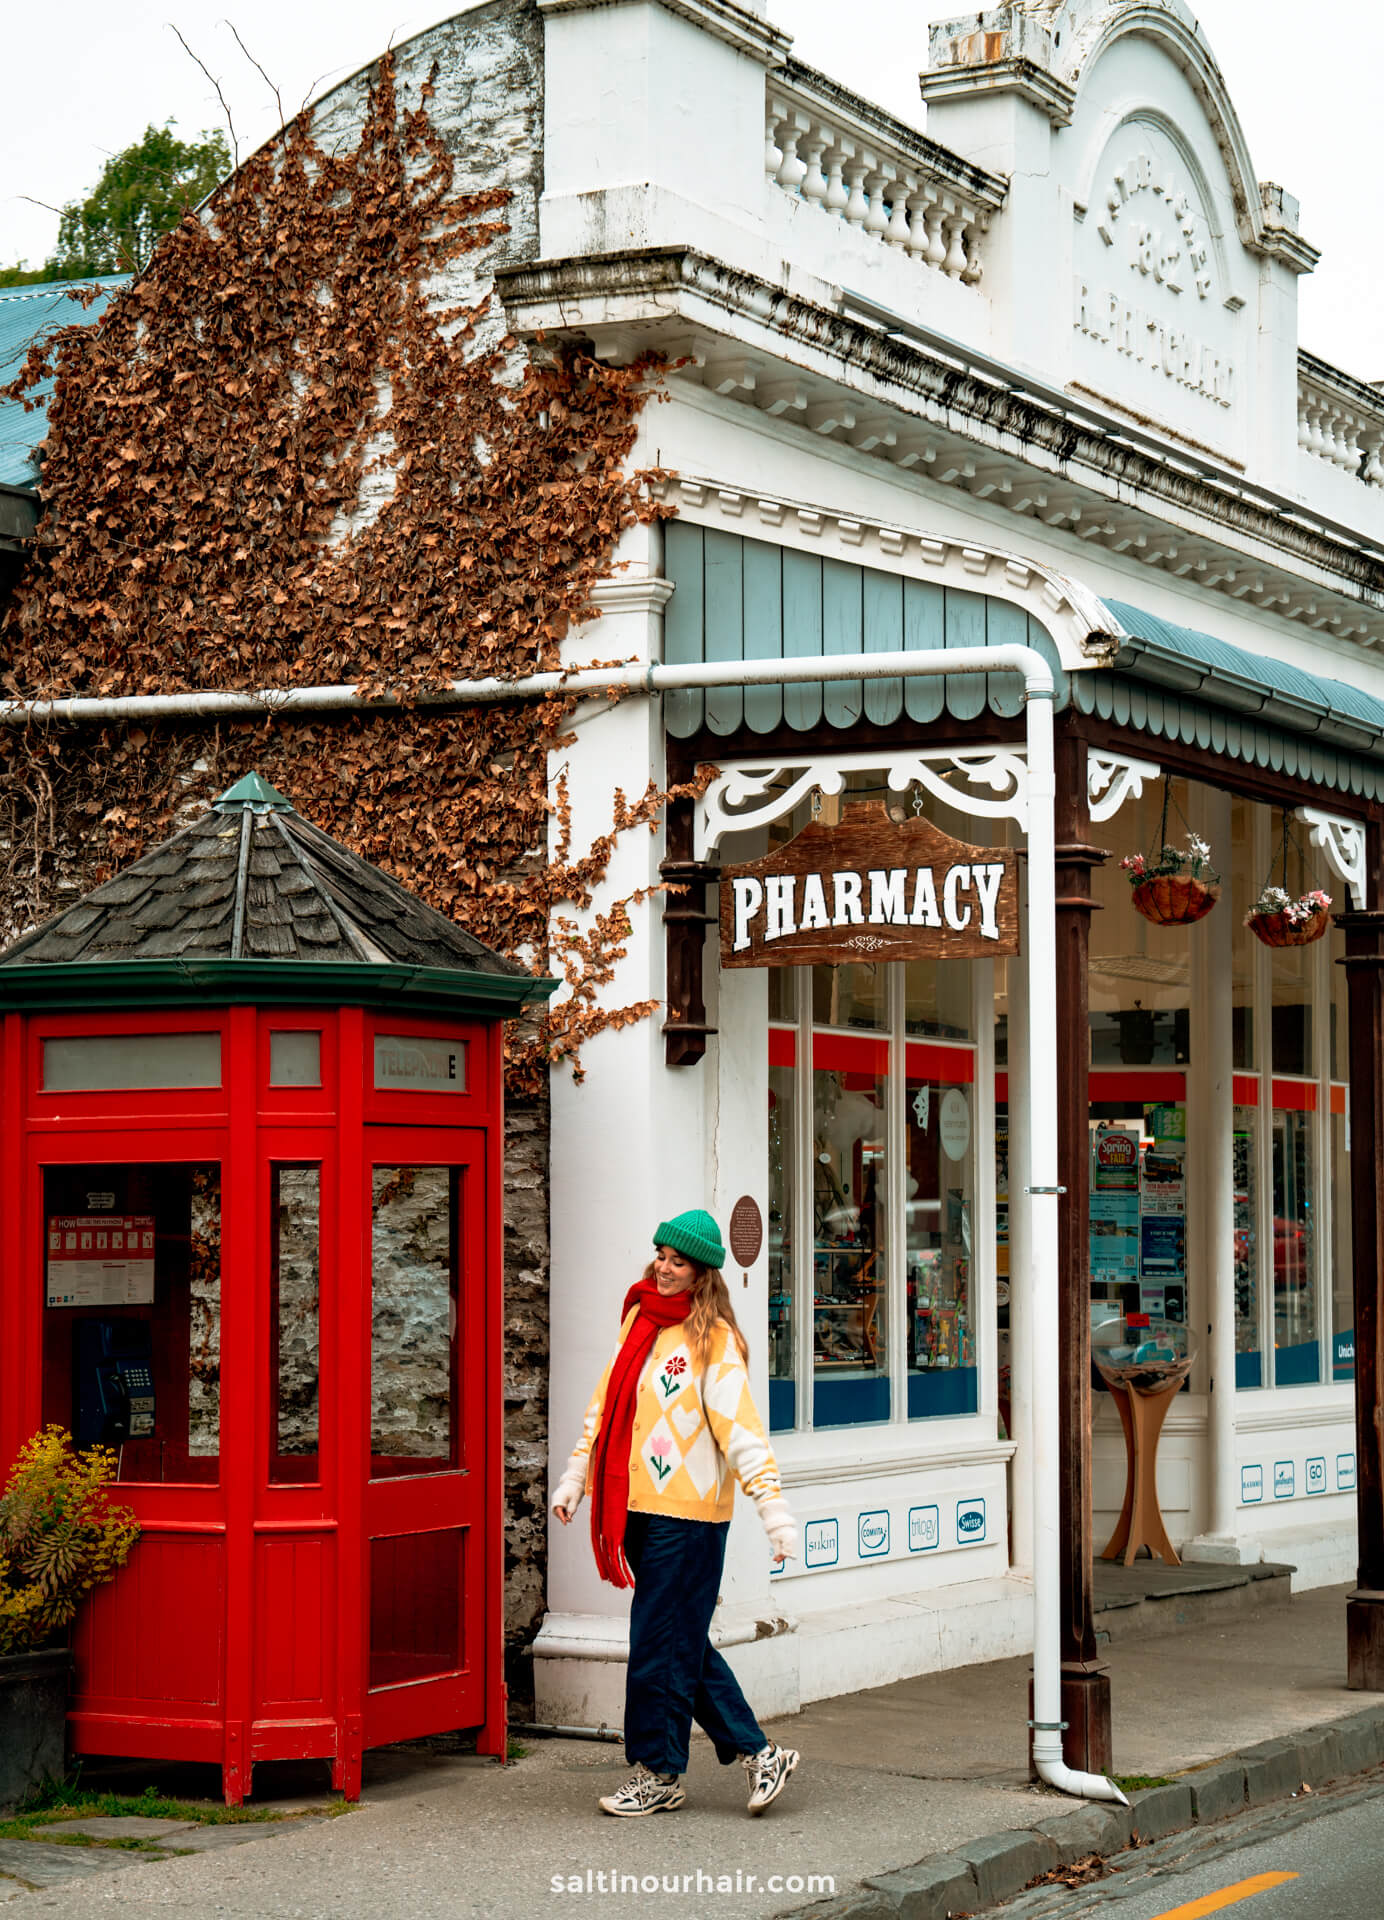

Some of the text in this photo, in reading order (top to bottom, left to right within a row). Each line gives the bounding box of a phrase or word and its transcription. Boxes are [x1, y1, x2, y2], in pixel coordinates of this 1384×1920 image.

[1097, 153, 1212, 301] ESTABLISHED
[732, 863, 1004, 952] PHARMACY
[1102, 1141, 1131, 1155] Spring
[58, 1219, 76, 1229] HOW
[1310, 1464, 1322, 1479] GO
[912, 1518, 936, 1540] trilogy
[961, 1514, 981, 1530] Swisse
[808, 1529, 835, 1552] sukin
[863, 1528, 883, 1538] COMVITA
